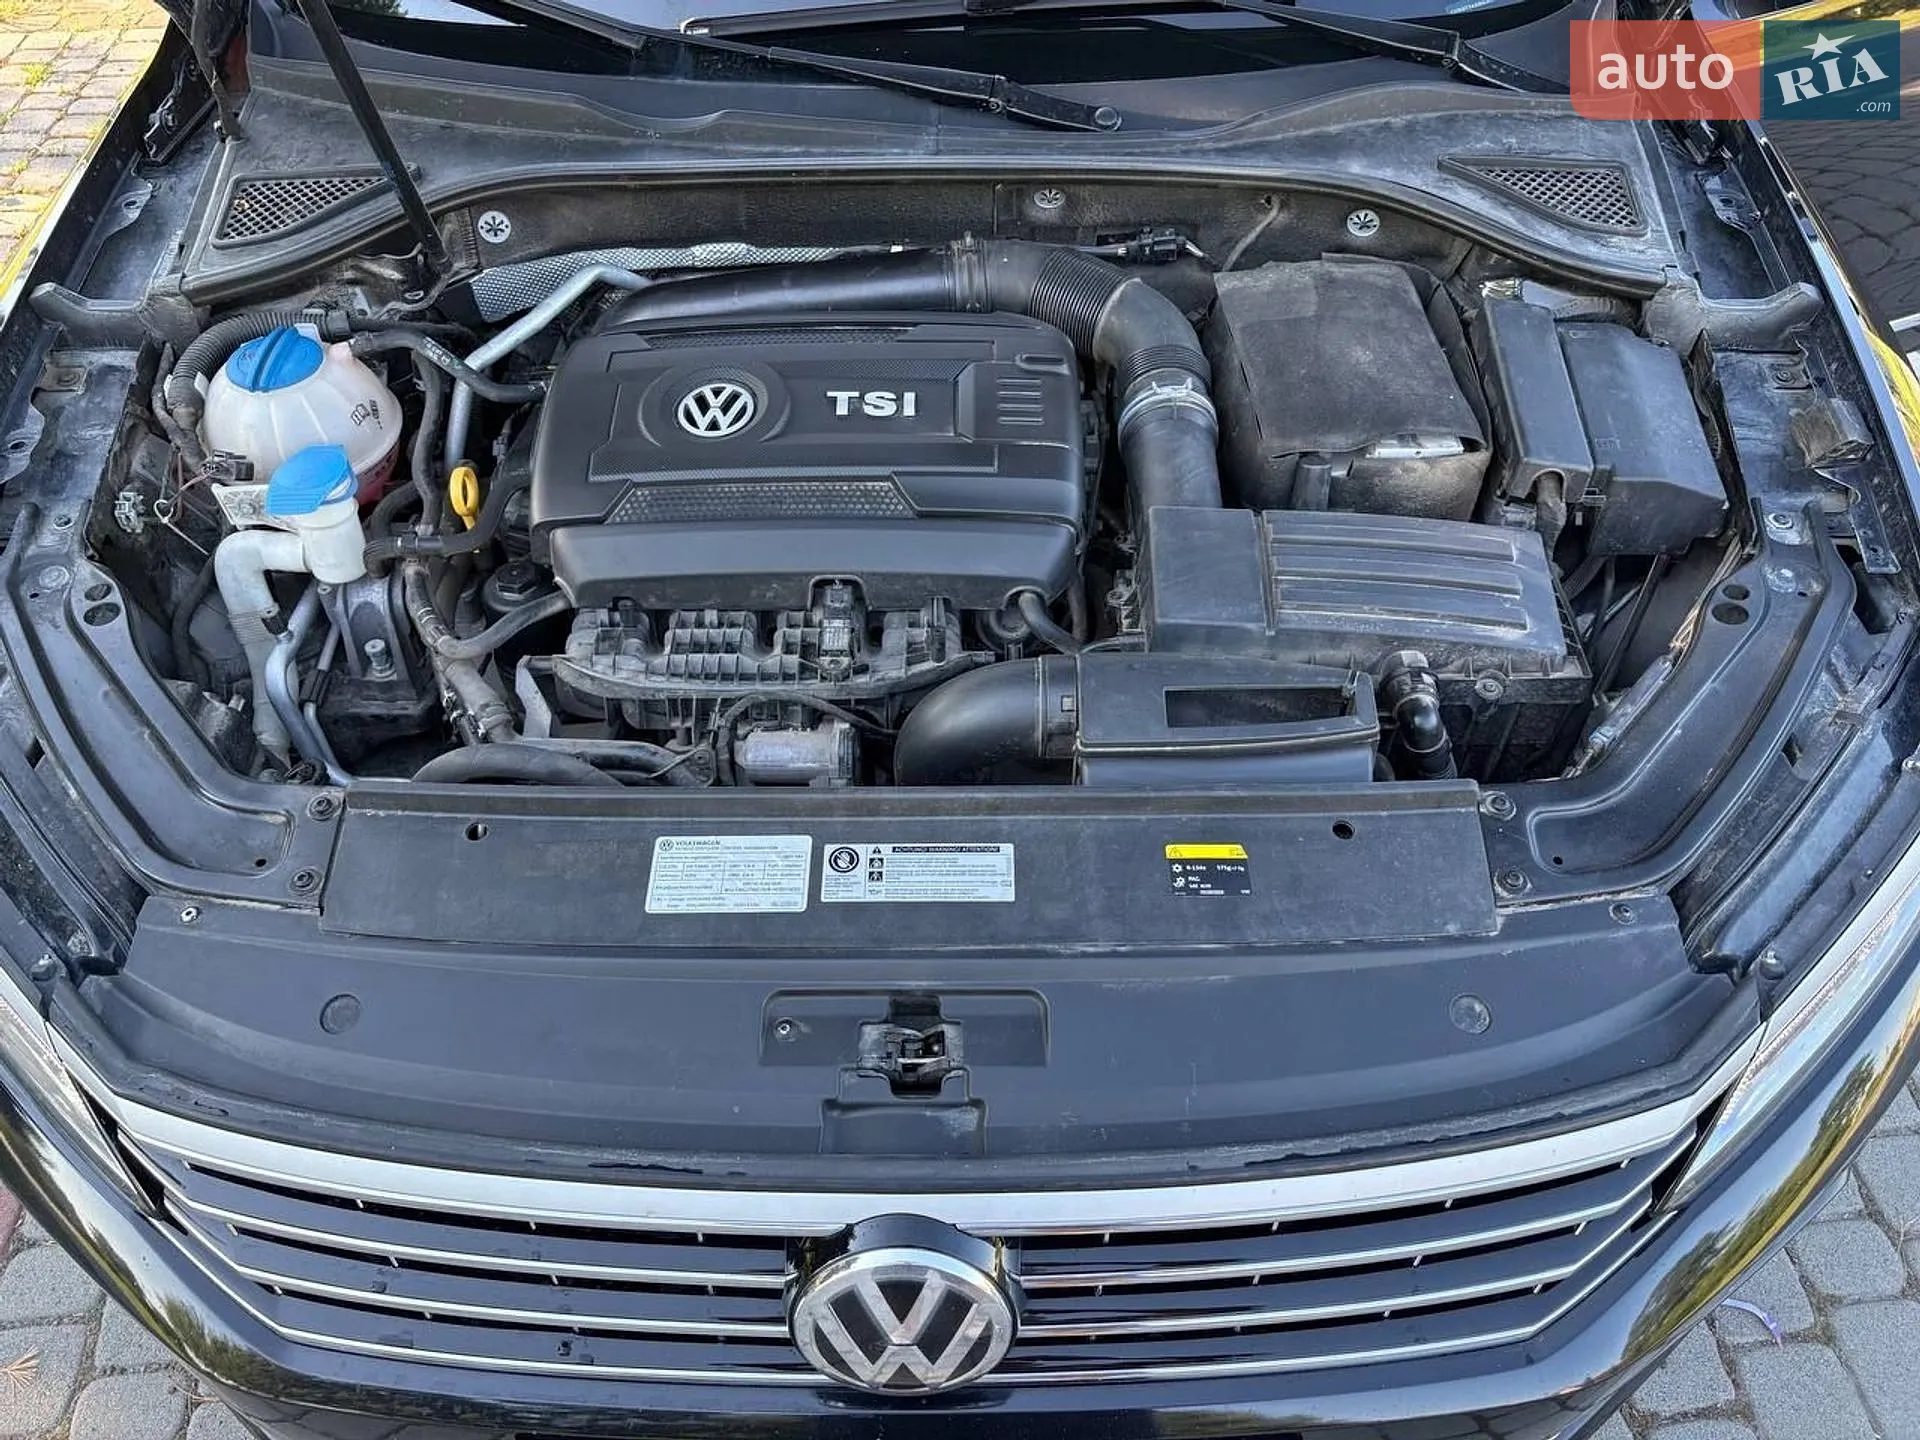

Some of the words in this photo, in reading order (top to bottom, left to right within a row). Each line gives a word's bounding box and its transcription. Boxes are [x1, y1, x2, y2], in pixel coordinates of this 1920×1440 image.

[678, 383, 755, 438] VW
[826, 391, 917, 417] TSI
[798, 1256, 1010, 1393] VW
